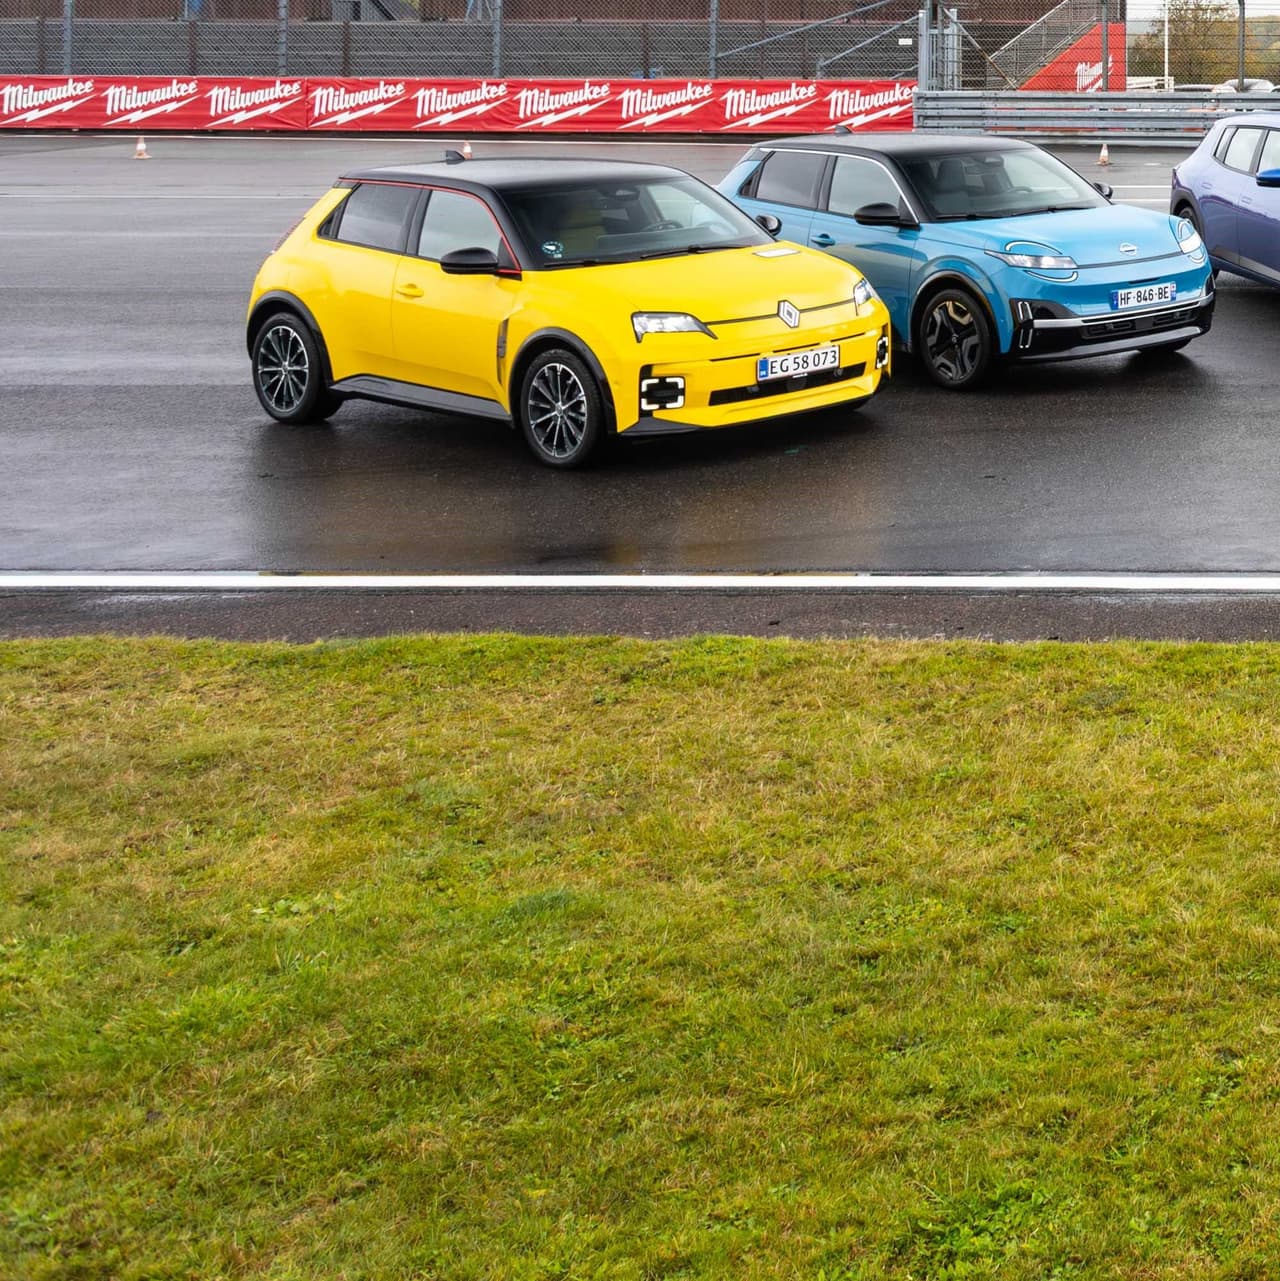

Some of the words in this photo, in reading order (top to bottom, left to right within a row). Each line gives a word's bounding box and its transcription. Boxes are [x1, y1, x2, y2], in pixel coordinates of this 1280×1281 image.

[0, 78, 94, 114] Milwaukee
[100, 79, 198, 116] Milwaukee
[204, 79, 302, 116] Milwaukee
[308, 80, 406, 117] Milwaukee
[411, 81, 508, 118] Milwaukee
[513, 82, 610, 118] Milwaukee
[615, 82, 712, 119] Milwaukee
[719, 82, 816, 120] Milwaukee
[770, 358, 789, 375] EG
[793, 354, 810, 371] 58
[812, 350, 837, 367] 073
